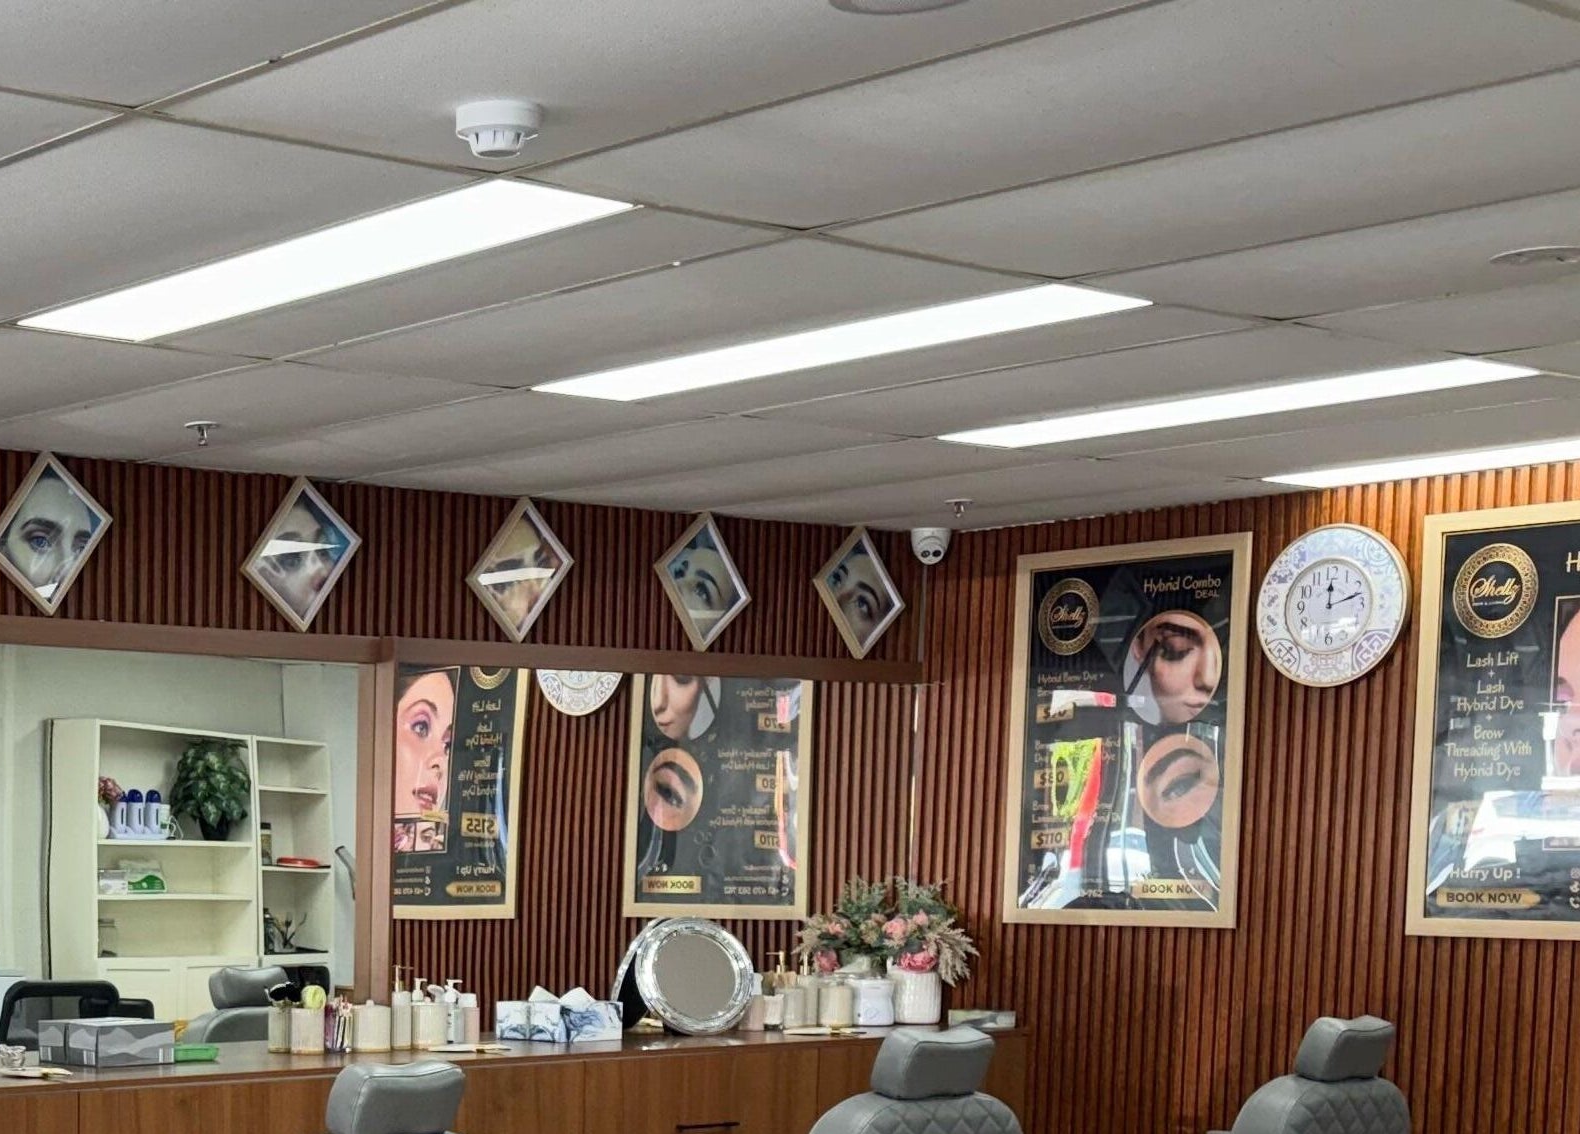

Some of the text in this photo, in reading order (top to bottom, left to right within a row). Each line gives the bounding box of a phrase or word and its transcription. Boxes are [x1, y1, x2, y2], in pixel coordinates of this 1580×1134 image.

[1313, 571, 1321, 586] 11
[1326, 565, 1338, 580] 12
[1144, 574, 1221, 597] Hybrid Combo
[1301, 585, 1312, 599] 10
[1195, 590, 1220, 599] DEAL
[1297, 597, 1365, 615] 9 3
[1324, 632, 1333, 645] 6
[1466, 651, 1519, 668] Lash Lift
[1488, 669, 1495, 678] +
[1477, 680, 1505, 695] Lash
[1456, 695, 1524, 717] Hybrid Dye
[1473, 725, 1504, 740] Brow
[1444, 740, 1532, 762] Threading With
[1453, 761, 1521, 783] Hybrid Dye
[1035, 832, 1062, 846] $110
[1449, 867, 1521, 882] Hurry Up !
[1142, 884, 1173, 894] BOOK
[1446, 892, 1521, 904] BOOK NOW
